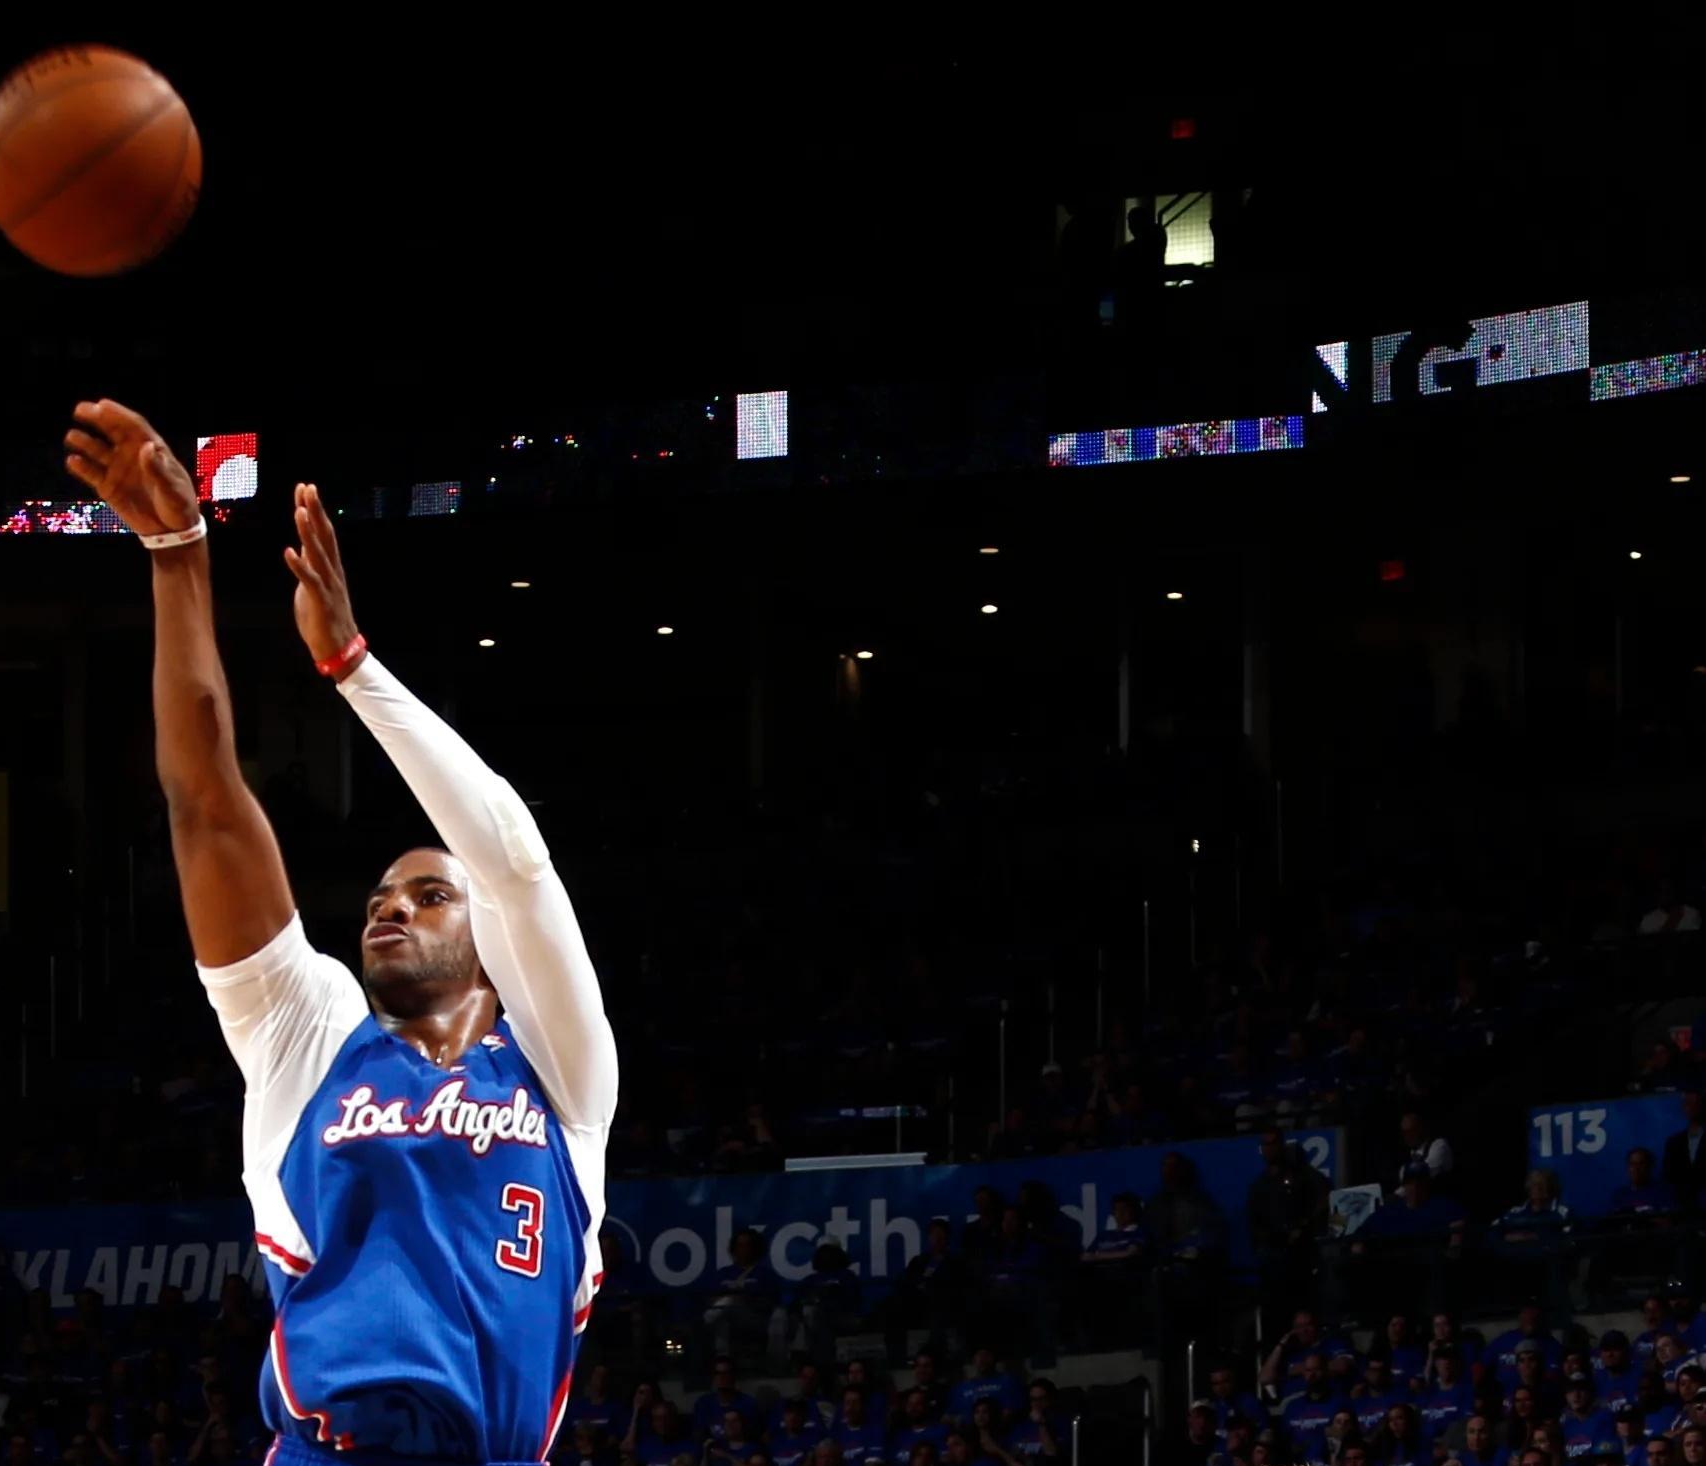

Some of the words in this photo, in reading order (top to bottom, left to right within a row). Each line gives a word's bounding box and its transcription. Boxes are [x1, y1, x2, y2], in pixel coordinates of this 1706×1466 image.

[323, 1086, 409, 1145] Los
[414, 1080, 548, 1156] Angeles
[1532, 1107, 1607, 1158] 113
[495, 1183, 544, 1278] 3
[11, 1241, 266, 1308] KLAHOM
